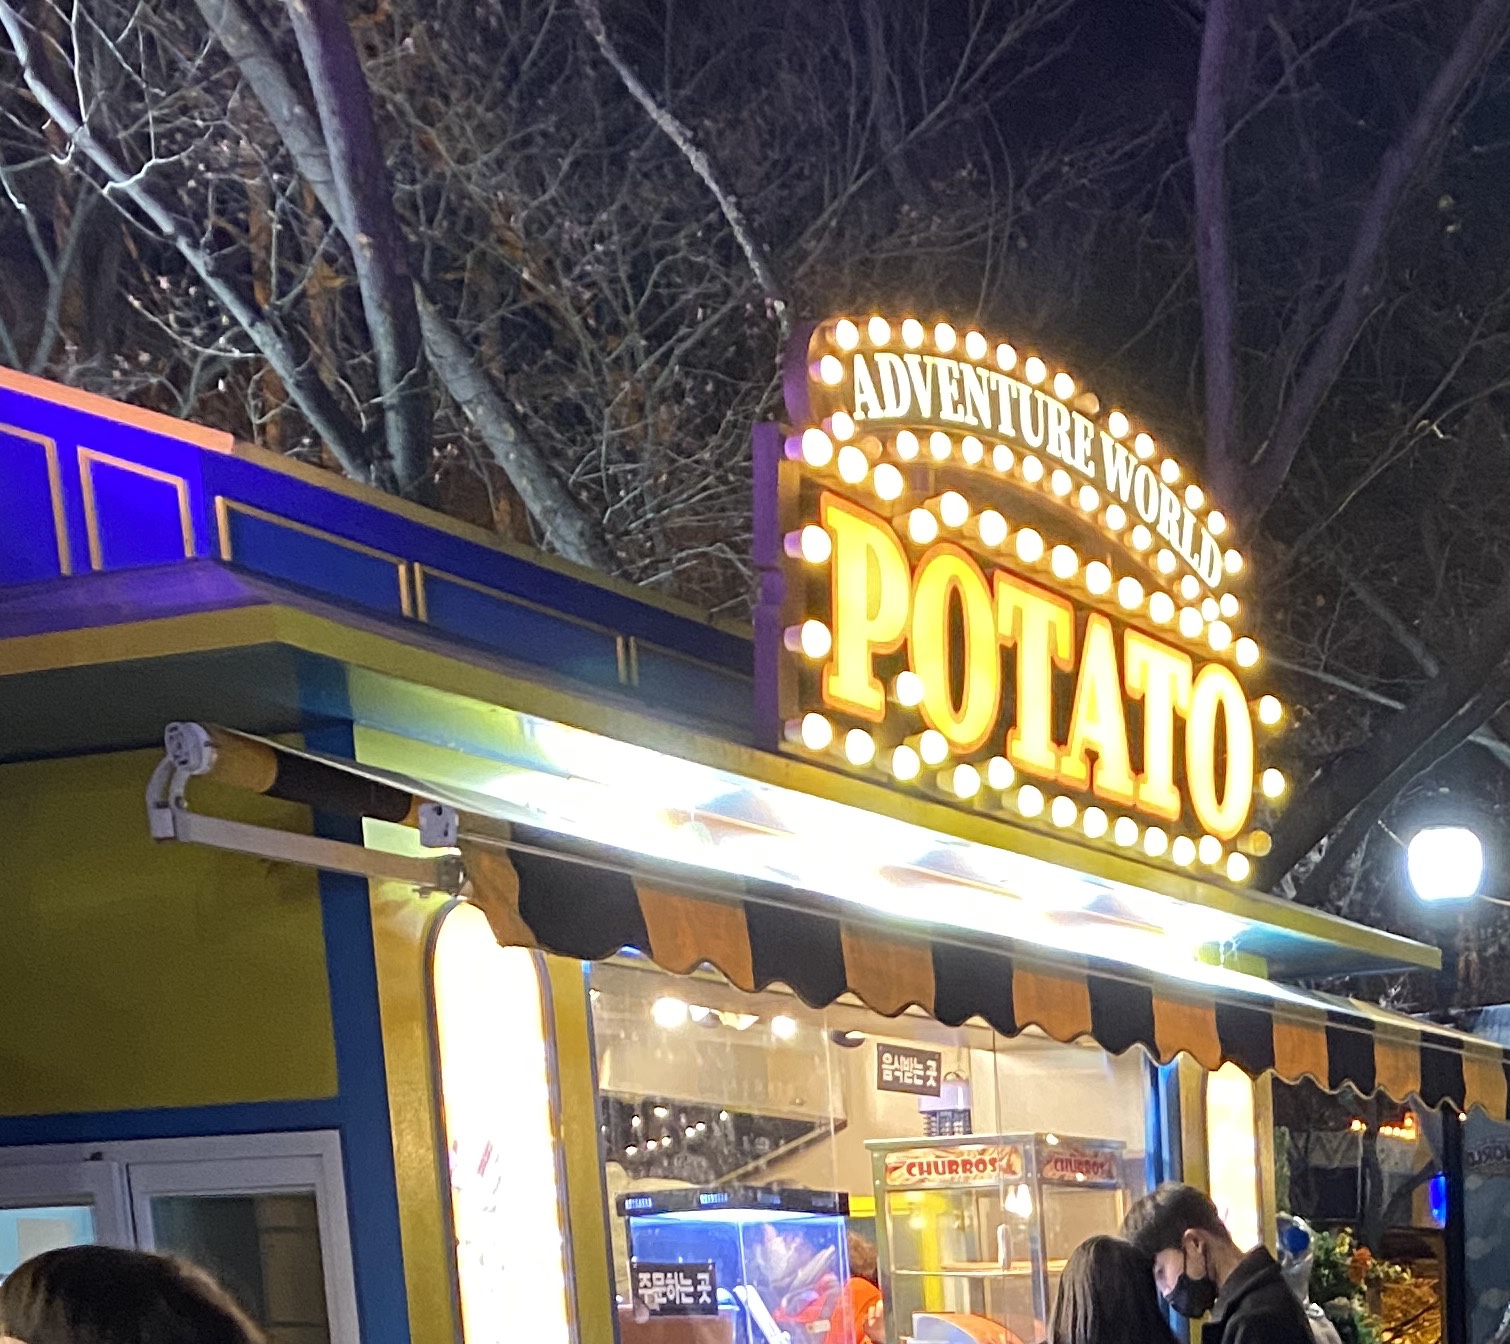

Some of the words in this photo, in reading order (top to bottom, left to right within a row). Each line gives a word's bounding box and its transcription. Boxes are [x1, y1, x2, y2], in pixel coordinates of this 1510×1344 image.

[852, 352, 1096, 478] ADVENTURE
[1099, 428, 1223, 588] WORLD
[820, 491, 1254, 840] POTATO
[881, 1052, 925, 1086] 음식받는
[926, 1059, 938, 1088] 곳
[906, 1156, 999, 1178] CHURROS
[638, 1271, 695, 1306] 주문하는
[696, 1272, 712, 1305] 곳
